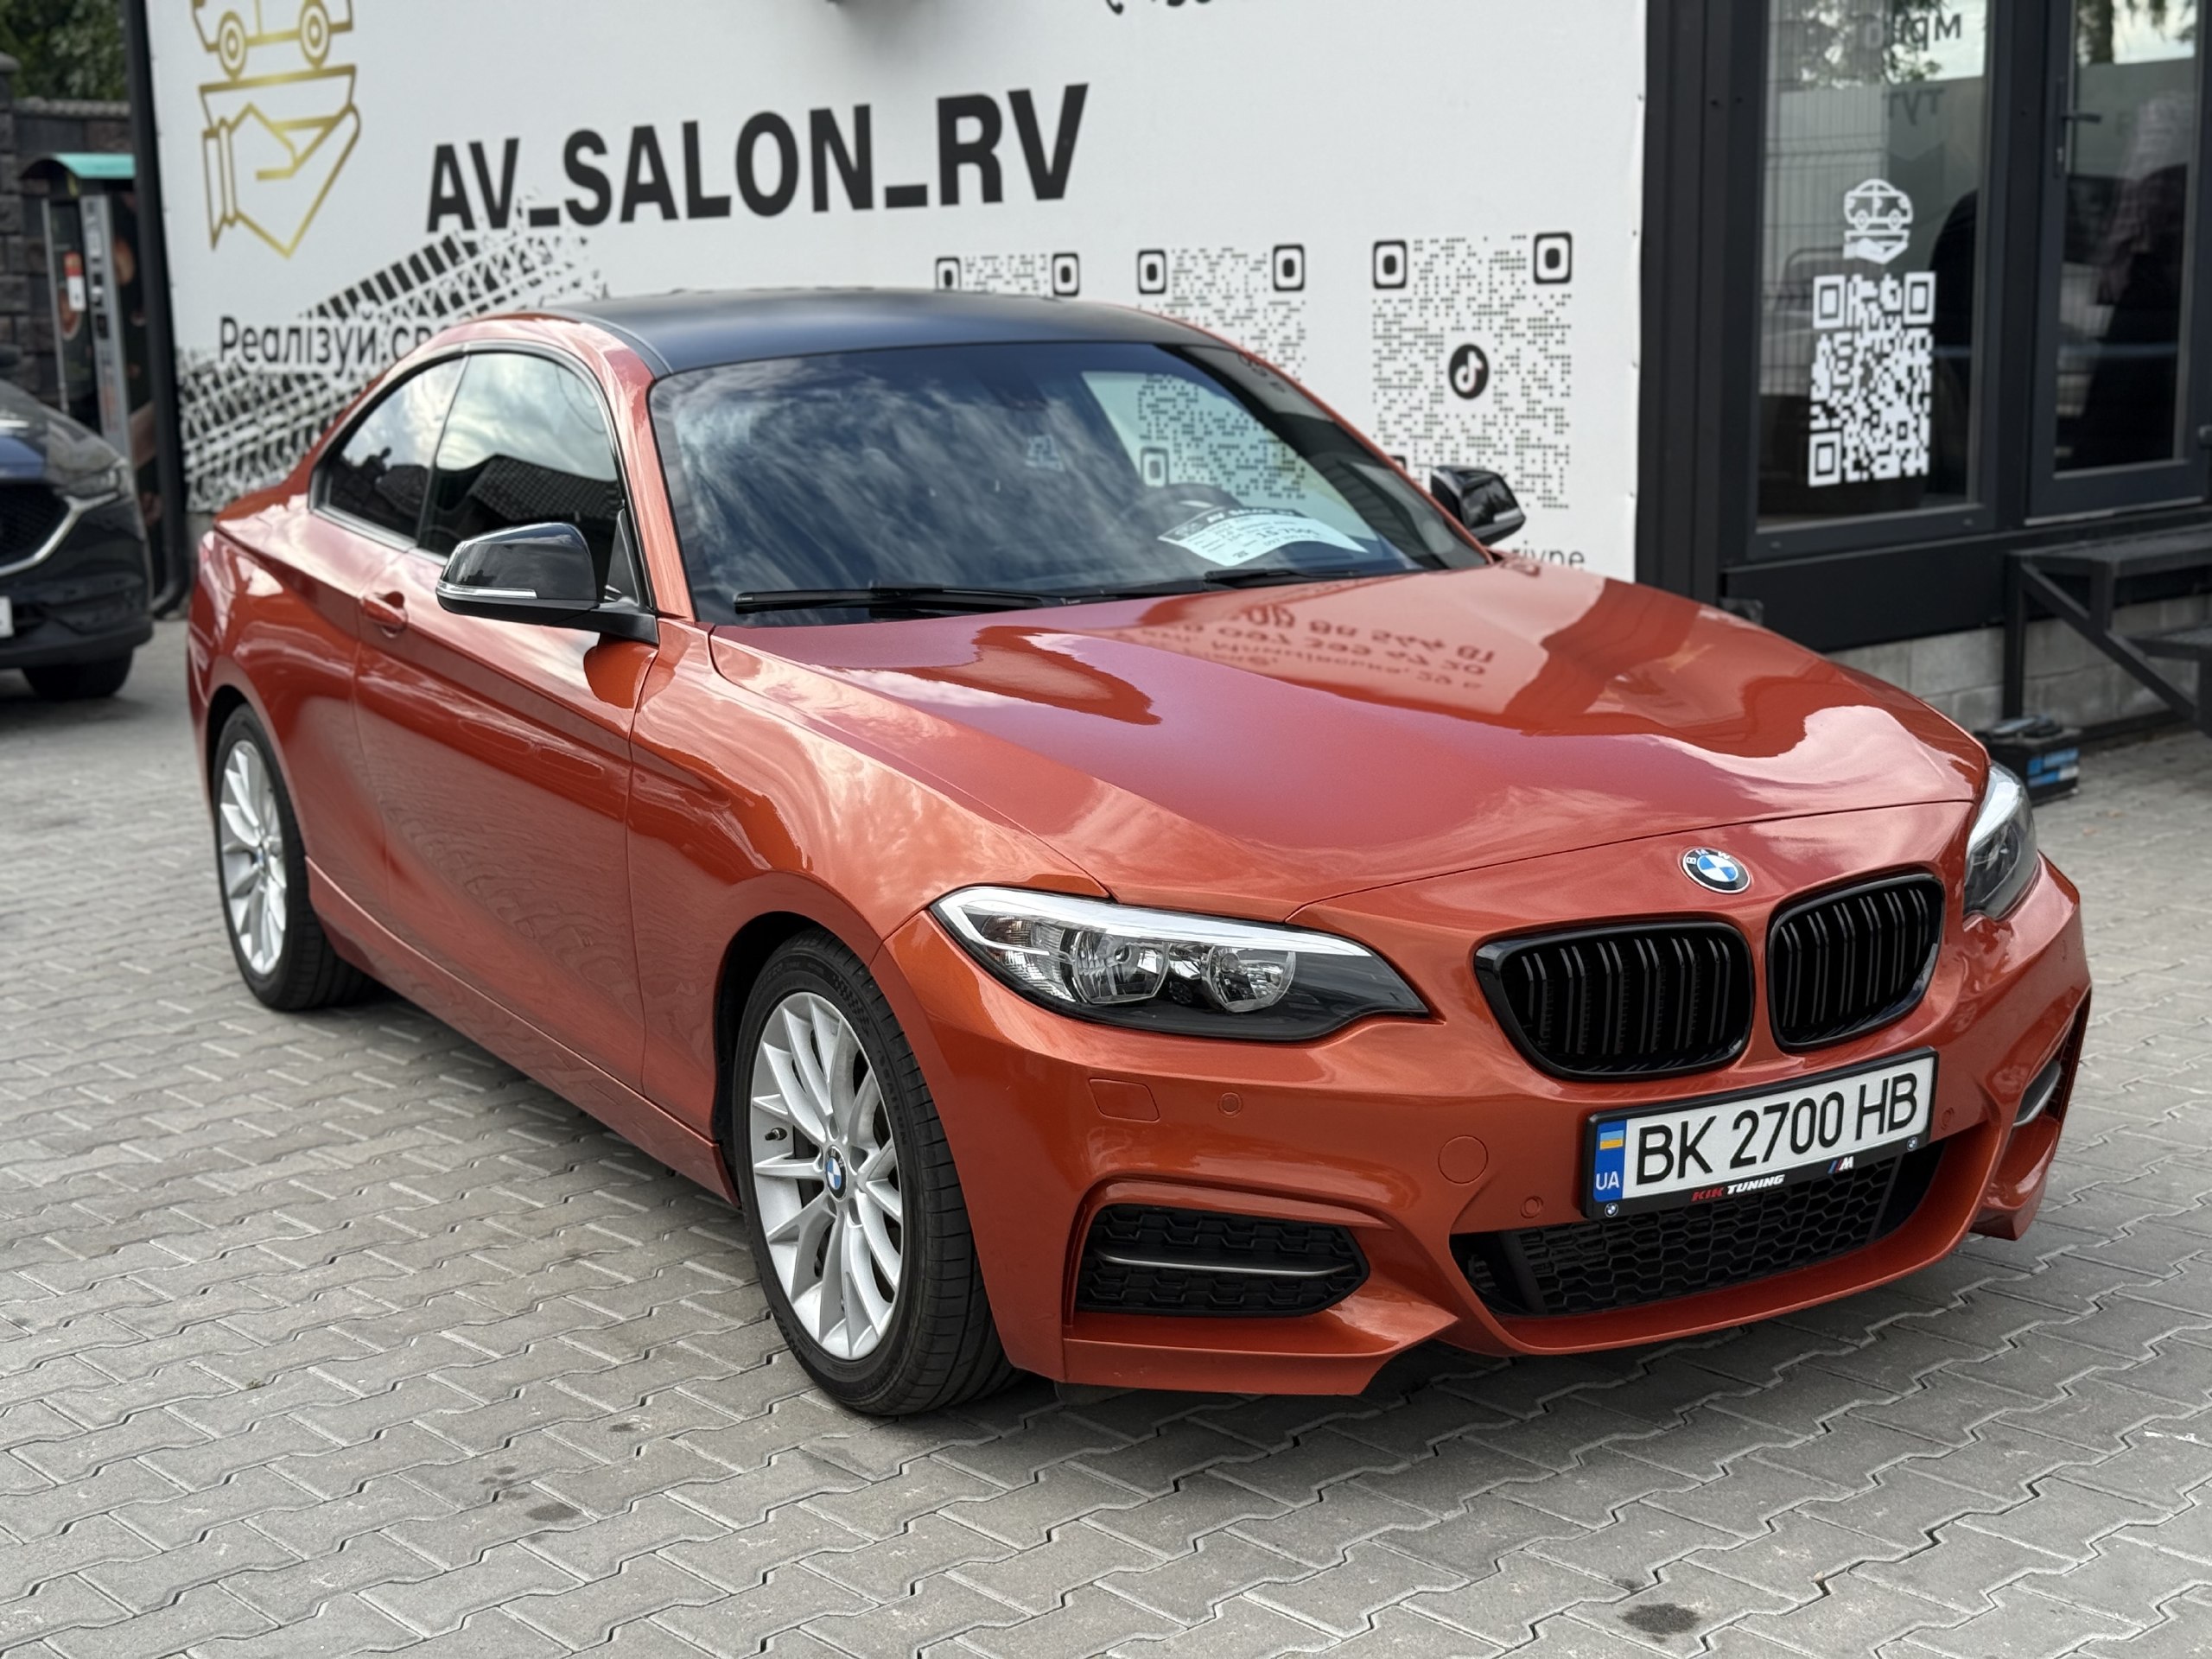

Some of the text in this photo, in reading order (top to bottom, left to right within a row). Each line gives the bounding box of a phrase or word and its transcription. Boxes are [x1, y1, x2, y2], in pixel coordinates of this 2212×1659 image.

[427, 84, 1089, 232] AV_SALON_RV
[219, 312, 378, 378] Реалізуй
[1686, 849, 1730, 865] BMW
[1637, 1072, 1917, 1185] BK 2700 HB
[1595, 1171, 1620, 1191] UA
[1727, 1174, 1786, 1195] TUNING
